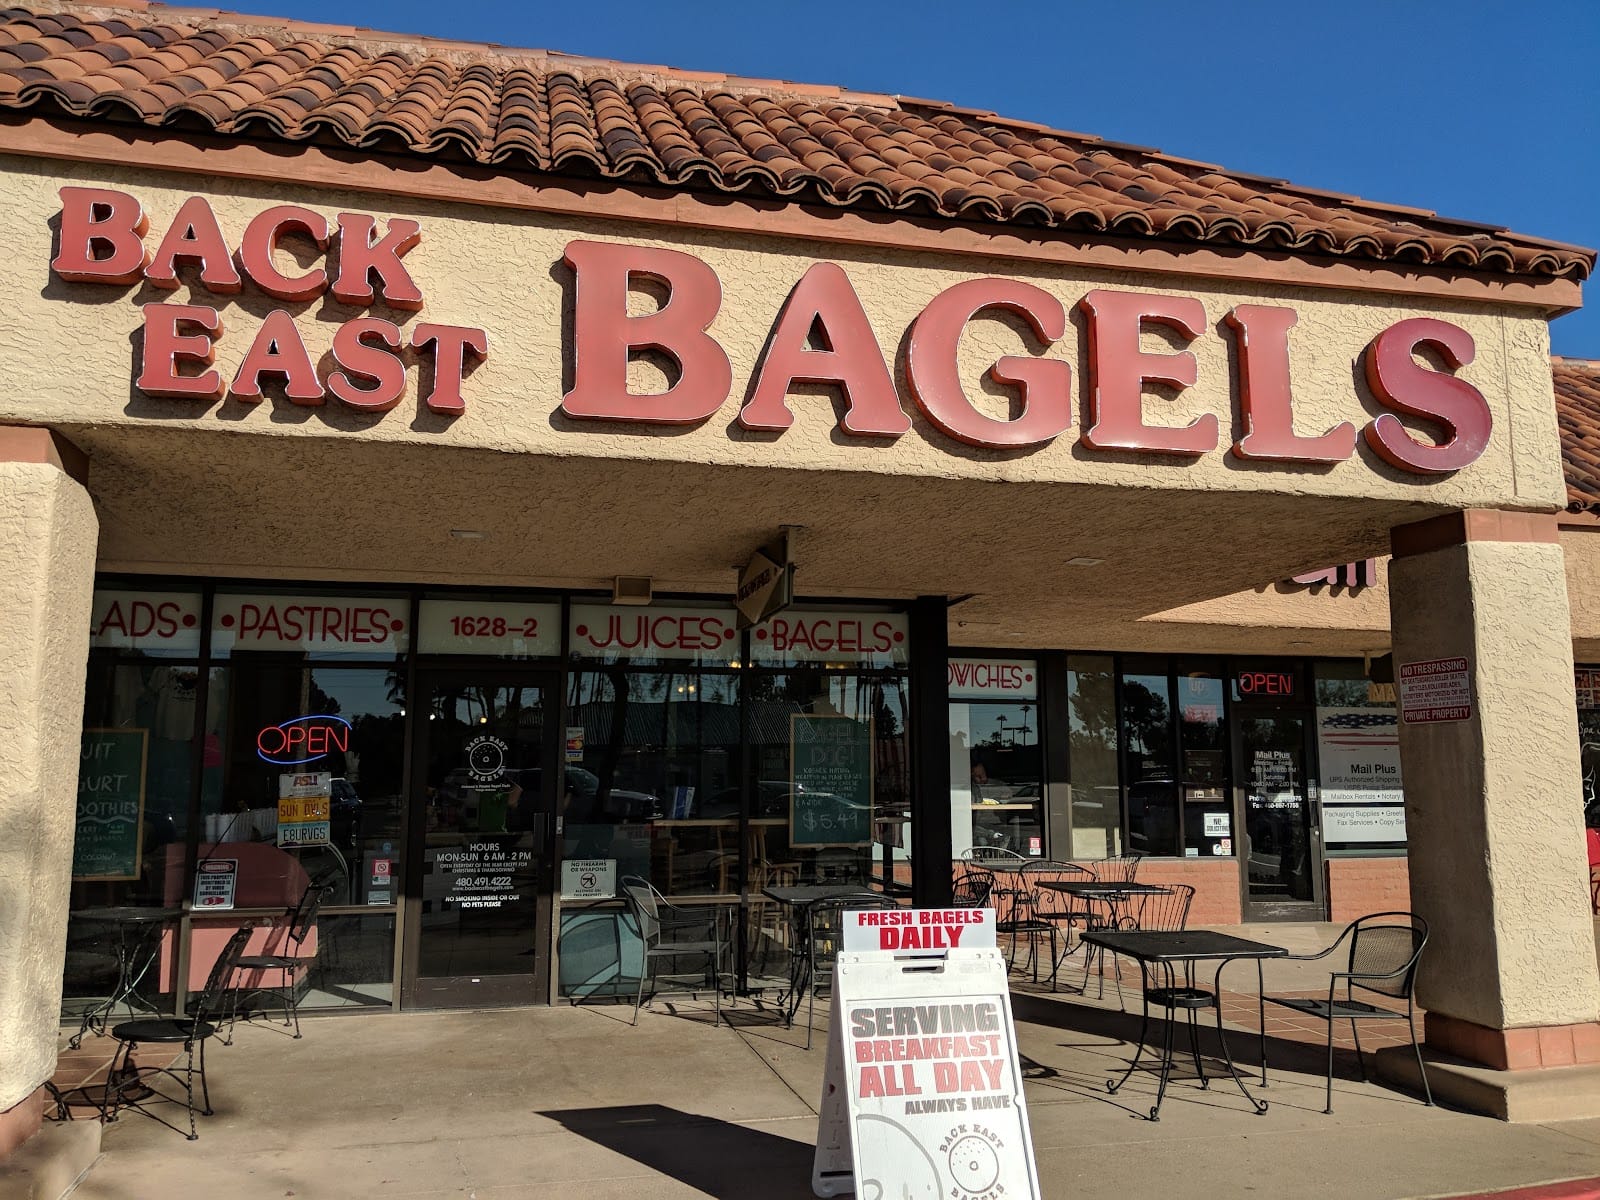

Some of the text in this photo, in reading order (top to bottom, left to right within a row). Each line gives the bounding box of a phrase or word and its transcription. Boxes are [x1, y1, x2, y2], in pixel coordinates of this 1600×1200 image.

[52, 187, 422, 310] BACK
[136, 303, 487, 416] EAST
[561, 240, 1492, 475] BAGELS
[90, 600, 180, 638] ADS
[239, 604, 391, 644] PASTRIES
[450, 616, 538, 638] 1628-2
[588, 615, 723, 650] JUICES
[771, 618, 892, 653] BAGELS
[1402, 660, 1465, 677] NO TRESPASSING
[1240, 673, 1292, 694] OPEN
[1404, 707, 1469, 721] PRIVATE PROPERTY
[256, 726, 349, 755] OPEN
[465, 736, 509, 752] BACK EAST
[293, 775, 318, 787] ASU
[1351, 764, 1396, 774] Mail Plus
[280, 804, 299, 817] SUN
[802, 809, 858, 833] $5.49
[436, 852, 479, 862] MON-SUN
[483, 853, 490, 861] 6
[491, 852, 505, 861] AM
[511, 852, 517, 861] 2
[518, 851, 532, 861] PM
[470, 843, 500, 852] HOURS
[455, 877, 512, 887] 480.491.4222
[858, 910, 984, 926] FRESH BAGELS
[879, 926, 964, 950] DAILY
[850, 1003, 1000, 1039] SERVING
[854, 1034, 1001, 1063] BREAKFAST
[859, 1059, 1005, 1099] ALL DAY
[904, 1095, 1011, 1116] ALWAYS HAVE
[939, 1123, 1006, 1153] BACK EAST
